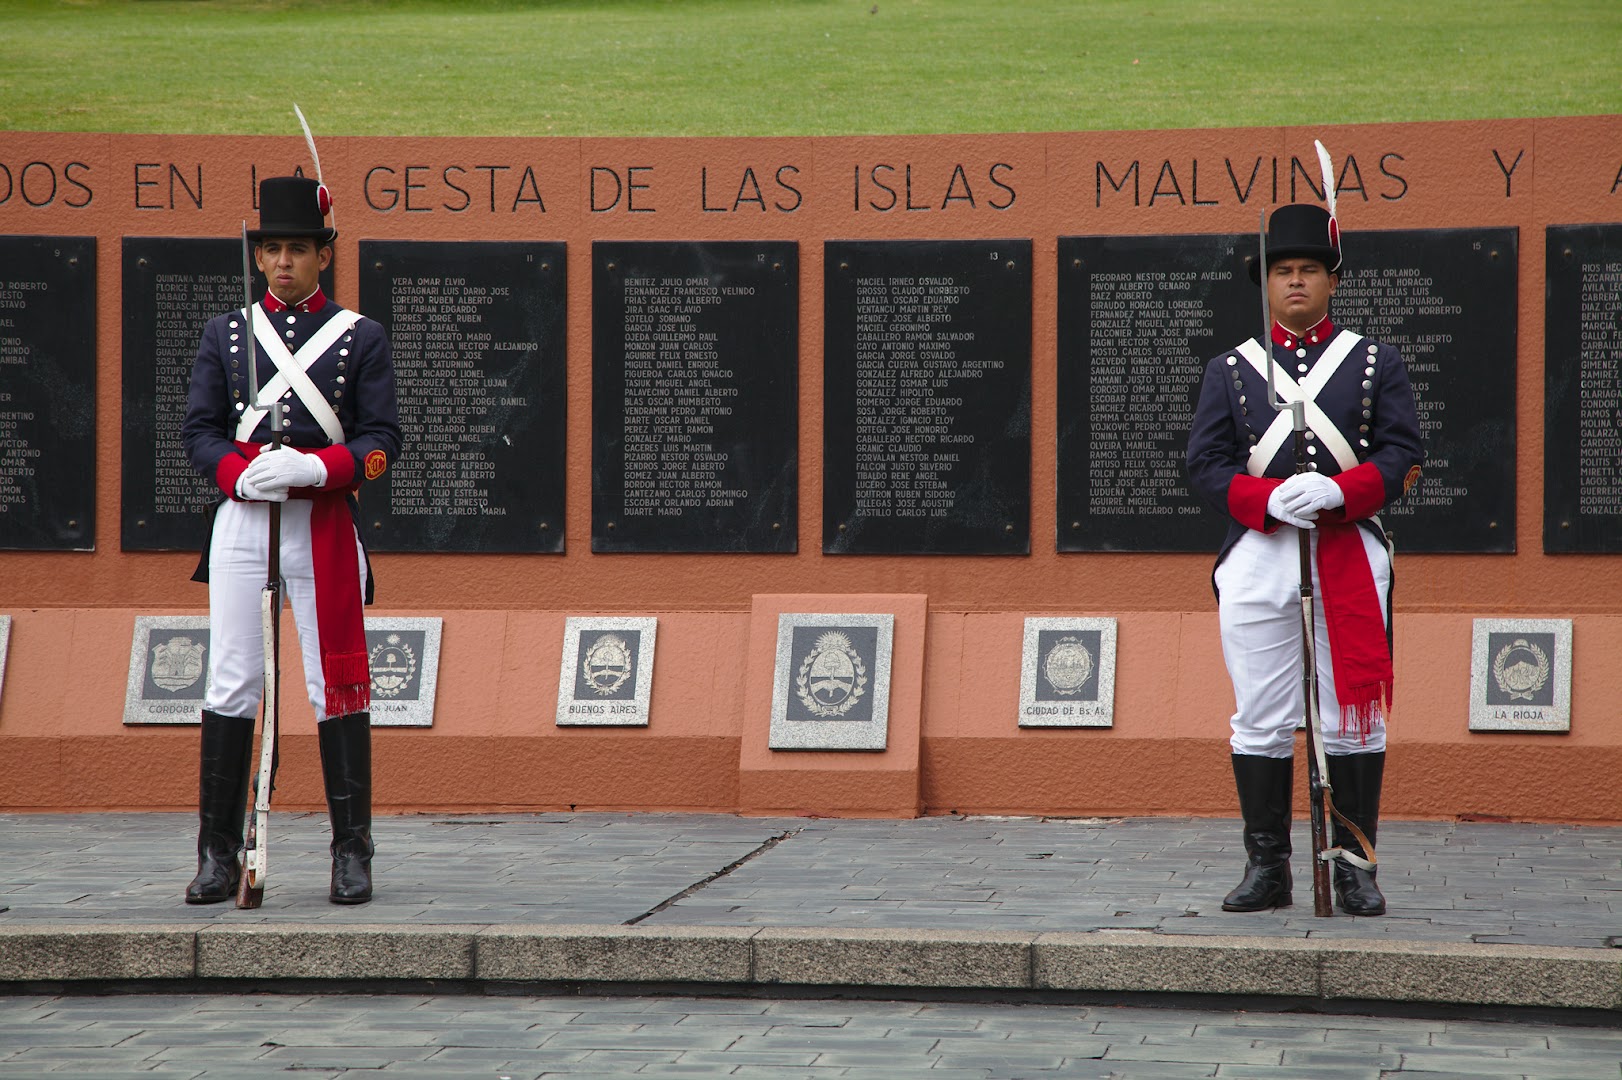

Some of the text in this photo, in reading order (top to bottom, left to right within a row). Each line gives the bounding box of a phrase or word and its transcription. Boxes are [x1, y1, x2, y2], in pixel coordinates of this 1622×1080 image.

[135, 163, 203, 210] EN
[364, 165, 546, 213] GESTA
[590, 167, 656, 213] DE
[702, 165, 803, 213] LAS
[854, 162, 1017, 212] ISLAS
[1096, 152, 1408, 208] MALVINAS
[1492, 149, 1525, 198] Y
[1472, 242, 1481, 250] 15
[54, 249, 61, 257] 9
[1226, 247, 1234, 255] 14
[757, 254, 765, 262] 12
[990, 252, 998, 260] 13
[393, 278, 465, 287] VERA OMAR ELVIO
[392, 287, 508, 296] CASTAGNARI LUIS DARIO JOSE
[625, 287, 754, 296] FERNANDEZ FRANCISCO VELINDO
[857, 287, 969, 296] GROSSO CLAUDIO NORBERTO
[392, 296, 492, 304] LOREIRO RUBEN ALBERTO
[857, 296, 959, 305] LABALTA OSCAR EDUARDO
[393, 305, 477, 314] SIRI FABIAN EDGARDO
[625, 324, 696, 332] GARCIA JOSE LUIS
[857, 333, 974, 342] CABALLERO RAMON SALVADOR
[393, 342, 538, 350] VARGAS GARCIA HECTOR ALEJANDRO
[392, 351, 481, 359] ECHAVE HORACIO JOSE
[625, 351, 717, 360] AGUIRRE FELIX ERNESTO
[857, 360, 1004, 369] GARCIA CUERVA GUSTAVO ARGENTINO
[625, 370, 732, 378] FIGUEROA CARLOS IGNACIO
[857, 370, 982, 379] GONZALEZ ALFREDO ALEJANDRO
[625, 388, 738, 397] PALAVECINO DANIEL ALBERTO
[625, 397, 720, 406] BLAS OSCAR HUMBERTO
[857, 397, 962, 406] ROMERO JORGE EDUARDO
[857, 434, 974, 443] CABALLERO HECTOR RICARDO
[625, 452, 728, 461] PIZARRO NESTOR OSVALDO
[856, 462, 952, 471] FALCON JUSTO SILVERIO
[392, 489, 488, 497] LACROIX TULIO ESTEBAN
[625, 489, 747, 498] CANTEZANO CARLOS DOMINGO
[625, 498, 733, 507] ESCOBAR ORLANDO ADRIAN
[392, 507, 506, 516] ZUBIZARRETA CARLOS MARIA
[149, 705, 196, 714] CORDOBA
[569, 705, 638, 714] BUENOS AIRES
[1026, 706, 1059, 716] CIUDAD
[1063, 706, 1075, 716] DE
[1494, 710, 1544, 720] LA RIOJA
